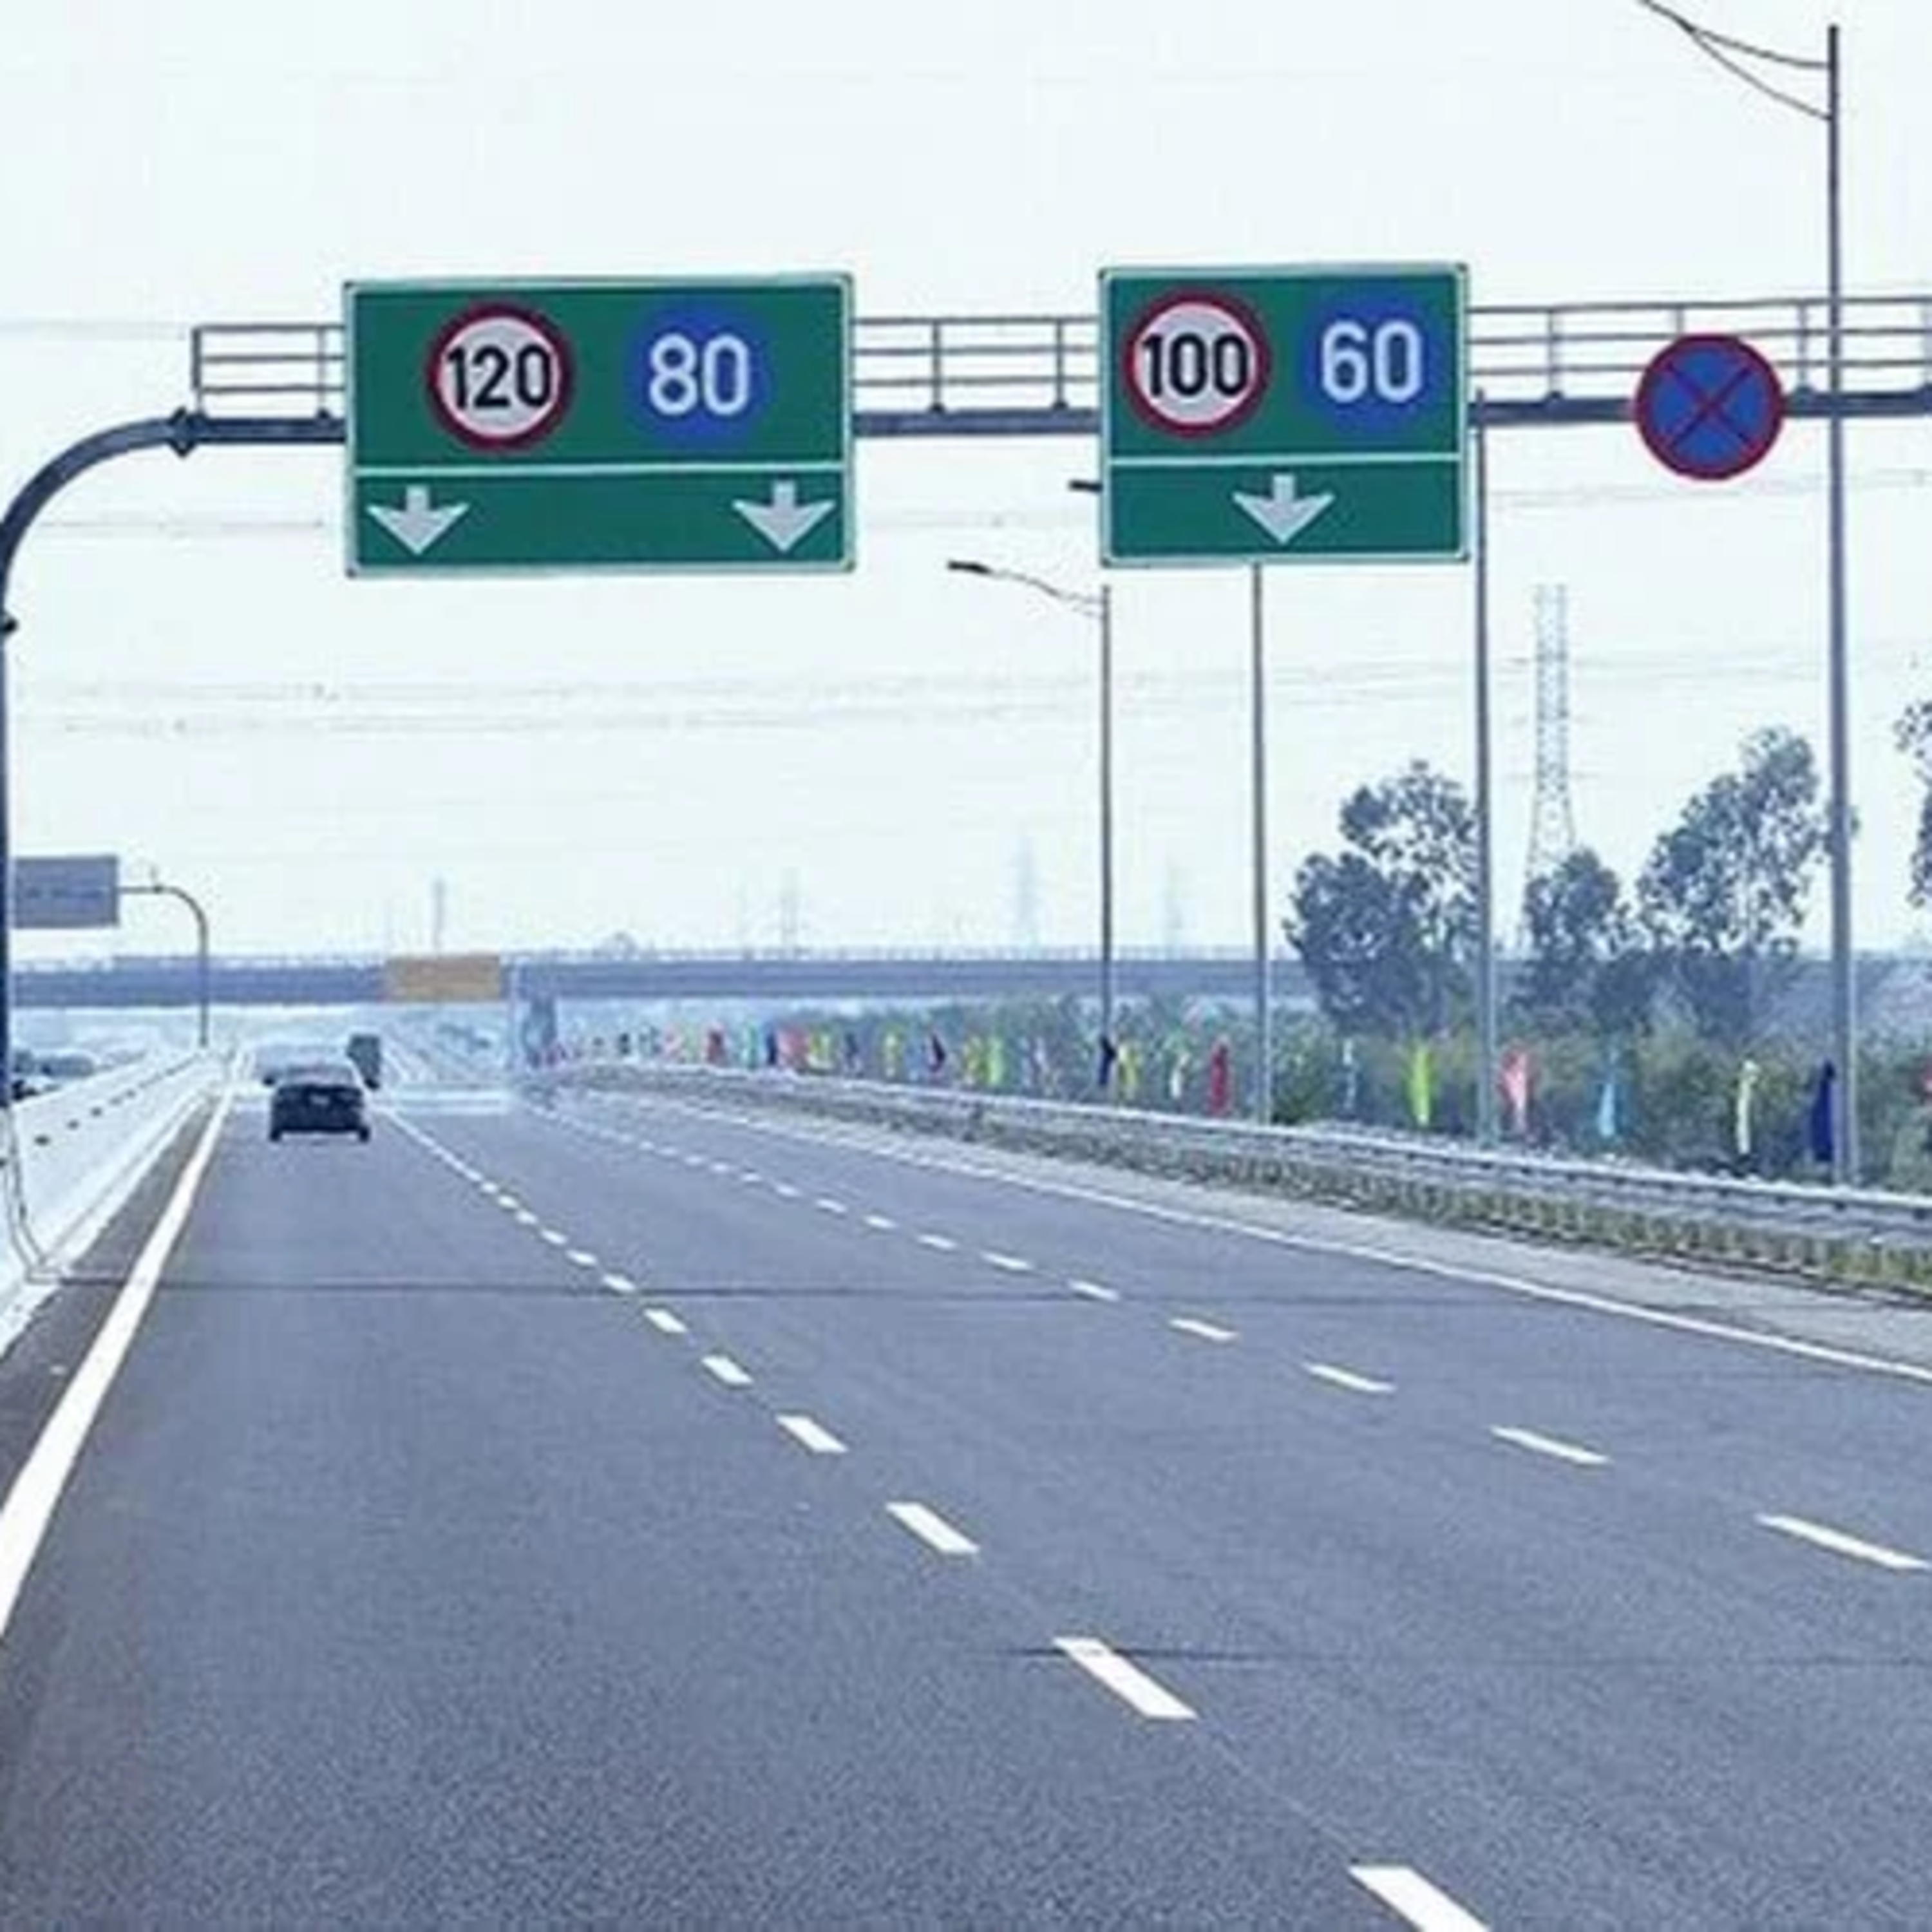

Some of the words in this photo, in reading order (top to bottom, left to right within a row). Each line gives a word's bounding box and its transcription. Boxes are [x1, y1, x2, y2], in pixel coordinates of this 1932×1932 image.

[446, 345, 553, 410] 120
[649, 334, 749, 415] 80
[1142, 333, 1248, 397] 100
[1322, 321, 1422, 402] 60
